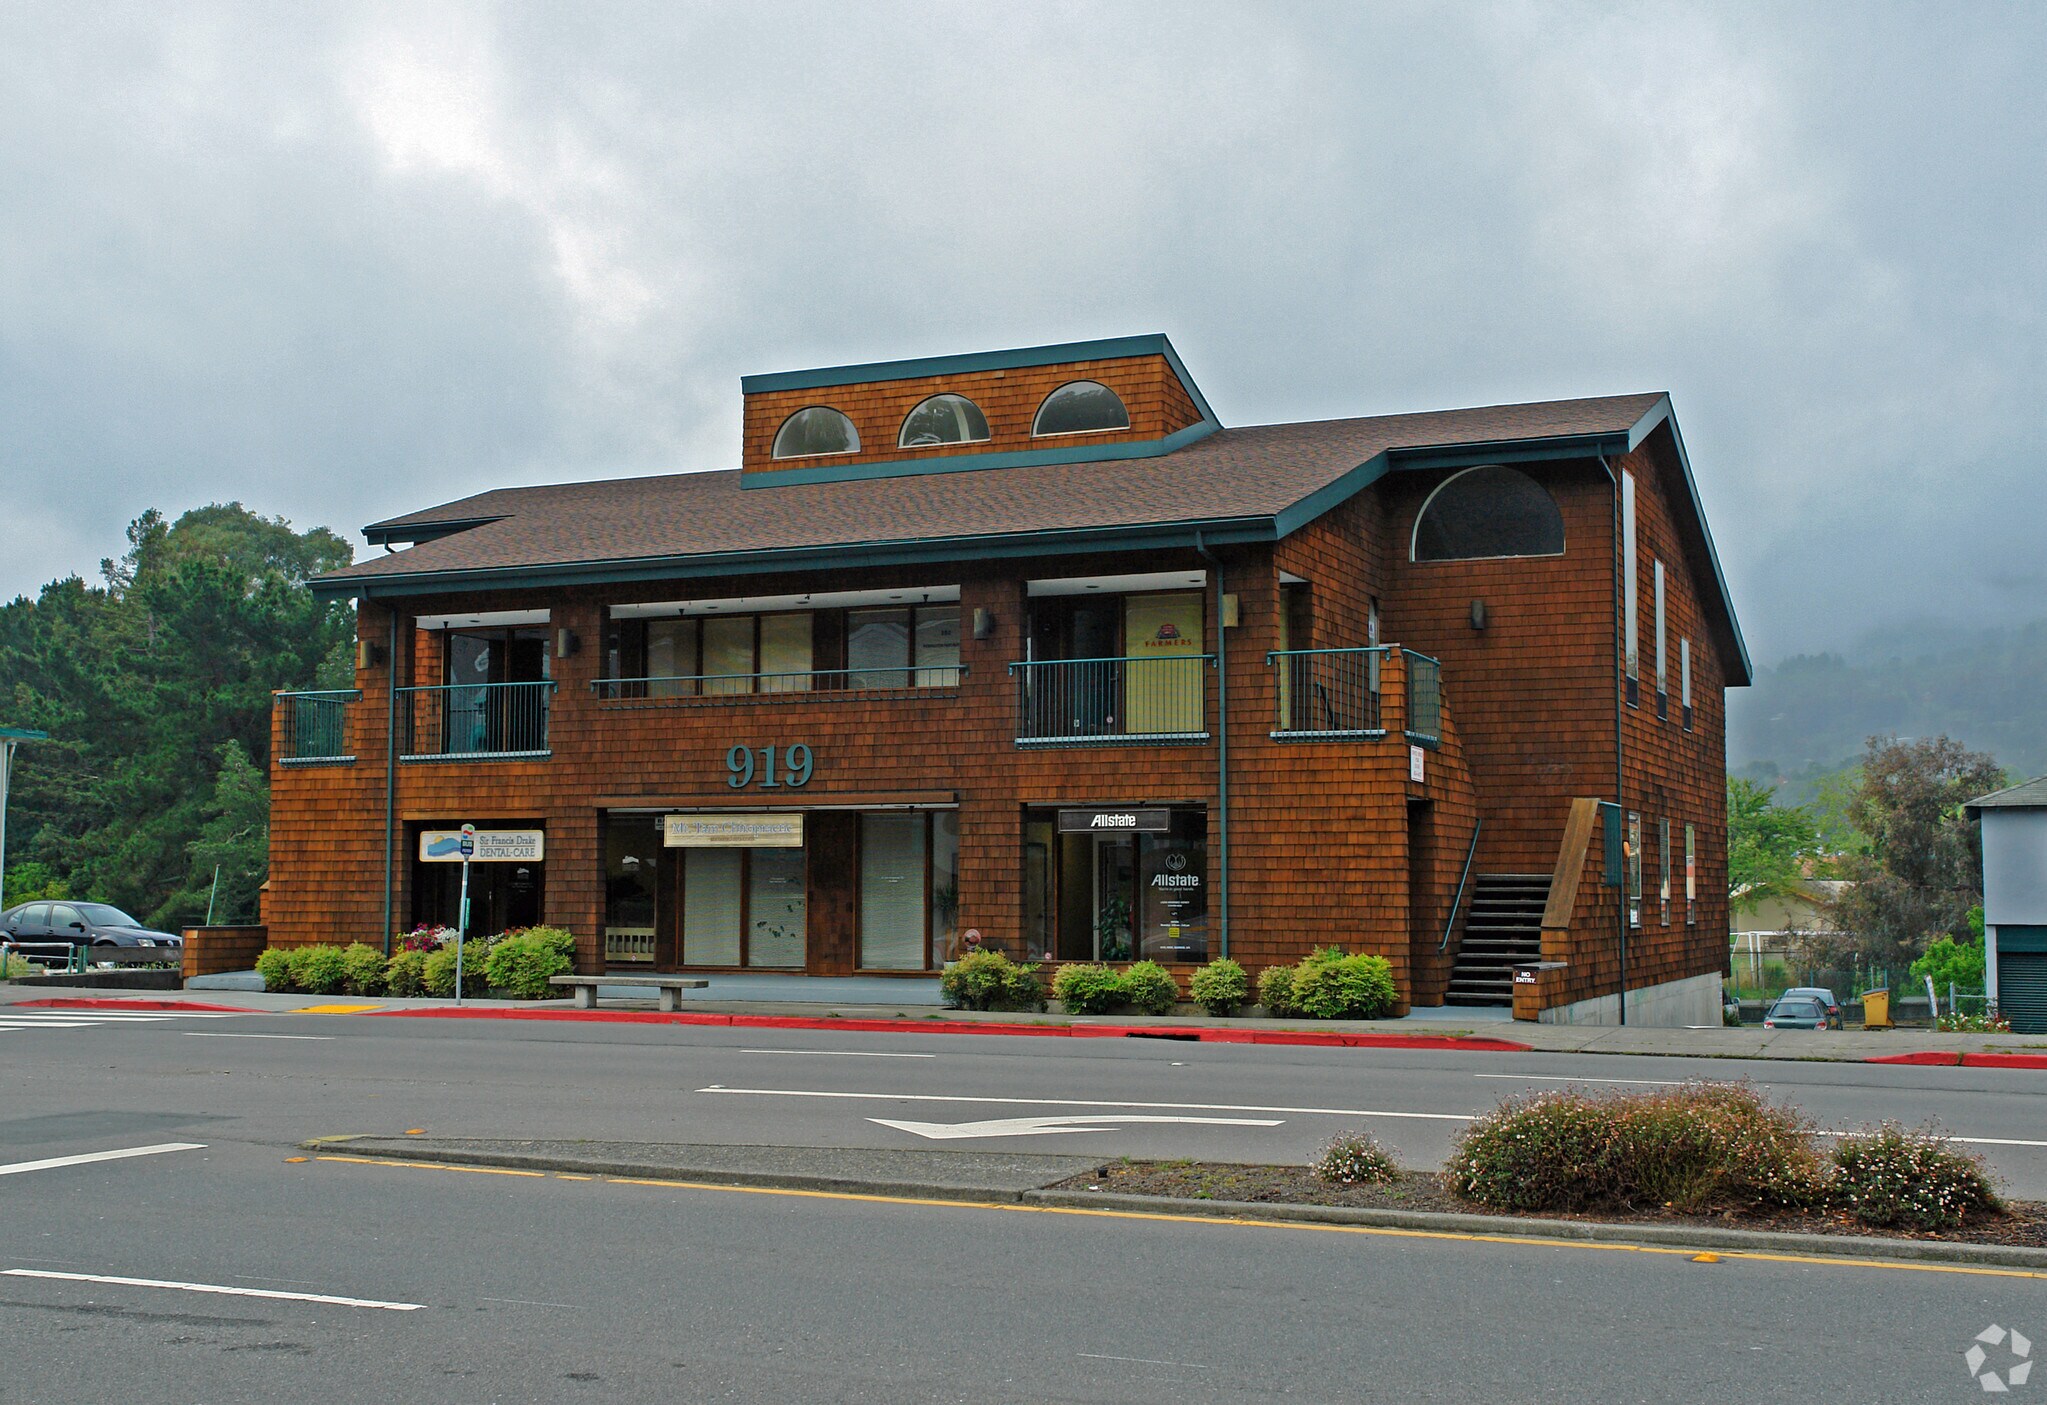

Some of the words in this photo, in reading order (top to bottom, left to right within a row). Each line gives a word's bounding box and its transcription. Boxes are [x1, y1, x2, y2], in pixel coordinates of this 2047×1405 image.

[1145, 639, 1192, 647] FARMERS
[726, 743, 814, 788] 919
[1090, 814, 1137, 827] Allstate
[672, 822, 691, 835] Mt.
[695, 822, 719, 834] Tam
[721, 821, 793, 838] Chiropractic
[479, 835, 489, 845] Sir
[491, 835, 514, 845] Francis
[516, 835, 536, 845] Drake
[1151, 874, 1199, 887] Allstate
[1515, 976, 1536, 984] ENTRY
